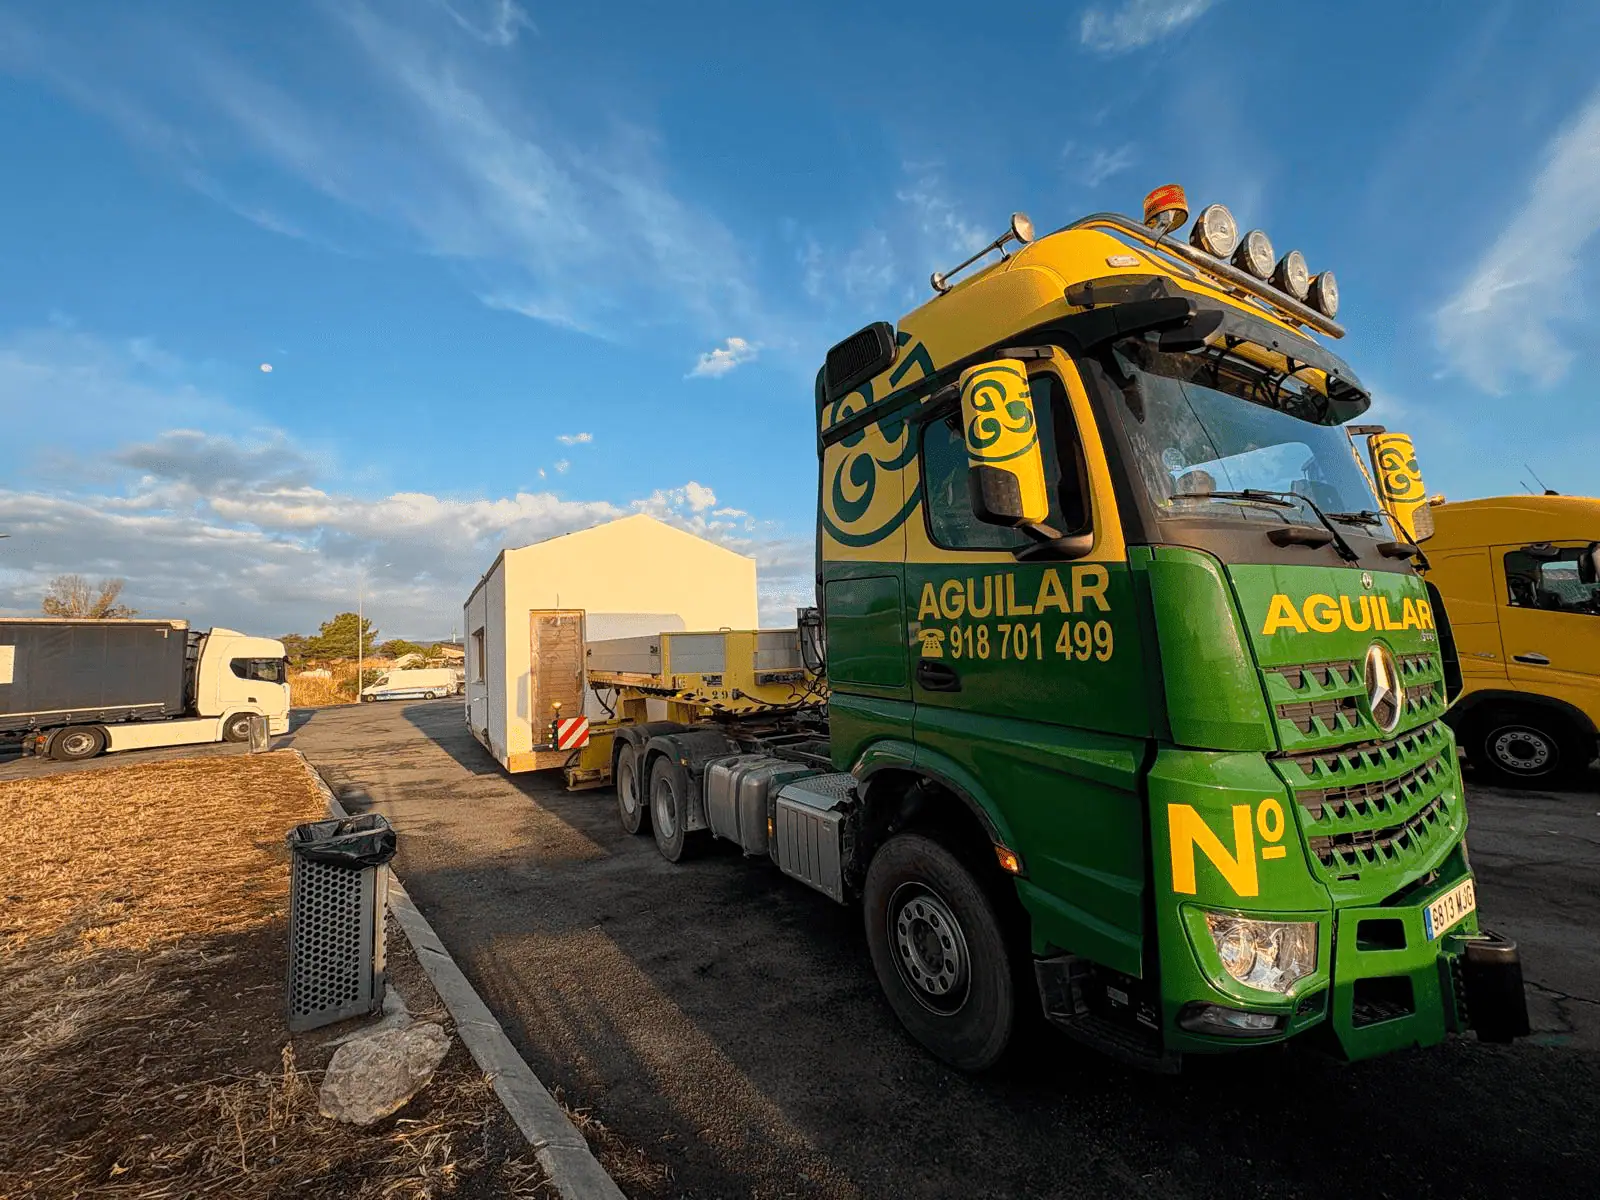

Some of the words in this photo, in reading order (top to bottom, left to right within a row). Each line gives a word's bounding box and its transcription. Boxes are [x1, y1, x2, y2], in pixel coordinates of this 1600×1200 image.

[917, 564, 1112, 621] AGUILAR
[1262, 593, 1435, 635] AGUILAR
[950, 625, 990, 660] 918
[997, 622, 1043, 660] 701
[1055, 620, 1114, 662] 499
[1432, 896, 1455, 931] 9813
